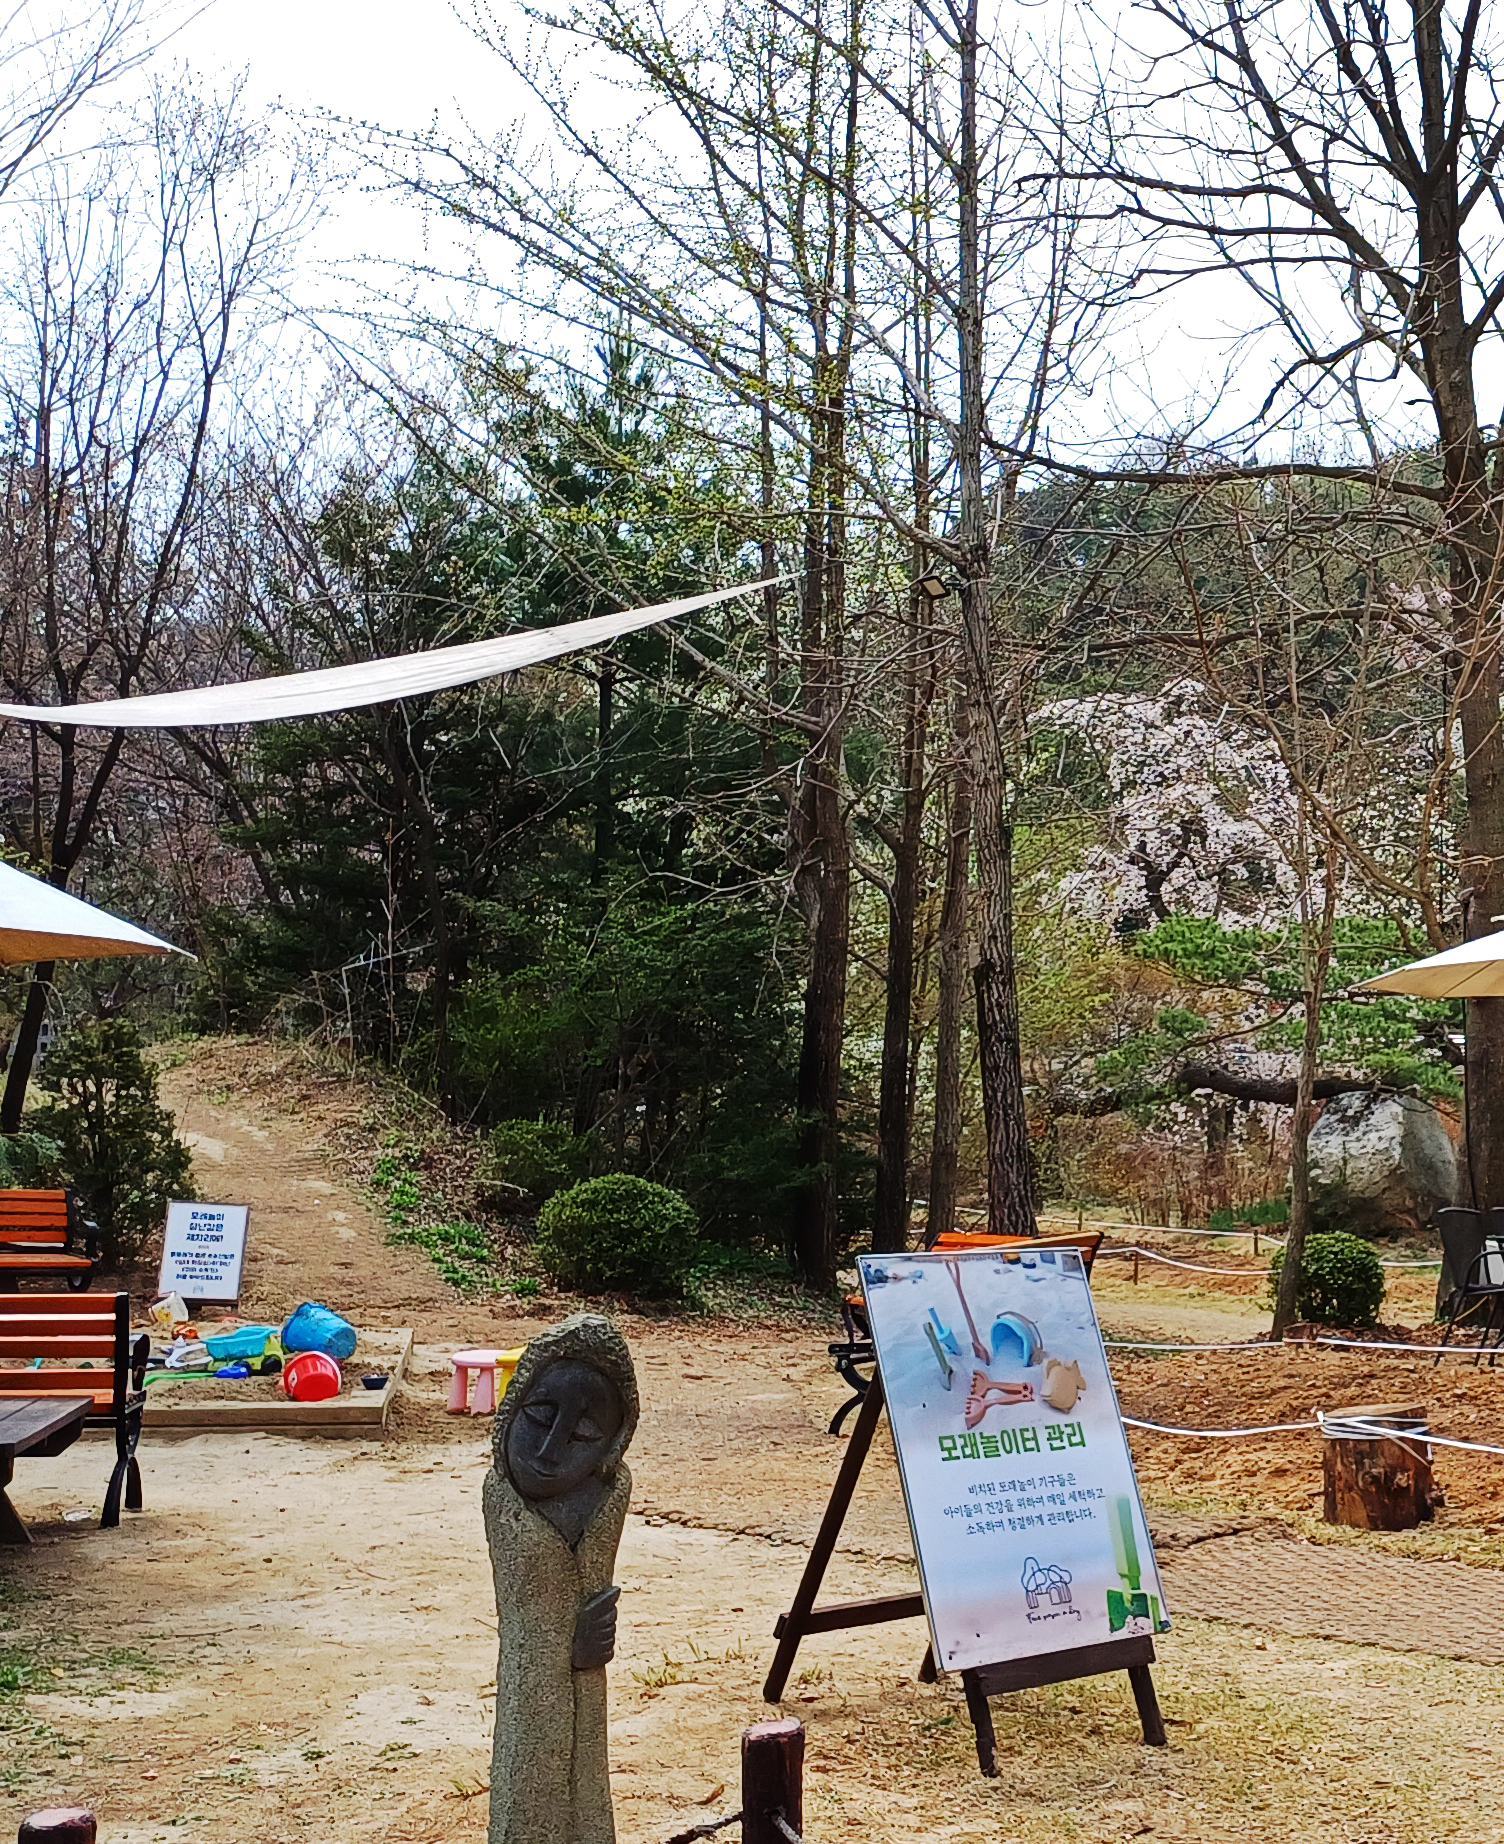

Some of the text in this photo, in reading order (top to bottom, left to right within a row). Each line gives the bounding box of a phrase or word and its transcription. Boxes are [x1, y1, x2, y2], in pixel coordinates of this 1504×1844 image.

[938, 1421, 1087, 1462] 모래놀이터 관리
[967, 1472, 1077, 1496] 비치된 모래놀이 기구들은
[943, 1488, 1106, 1518] 아이들의 건강을 위하여 매일 세척하고
[966, 1507, 1097, 1535] 소독하여 청결하게 관리합니다.
